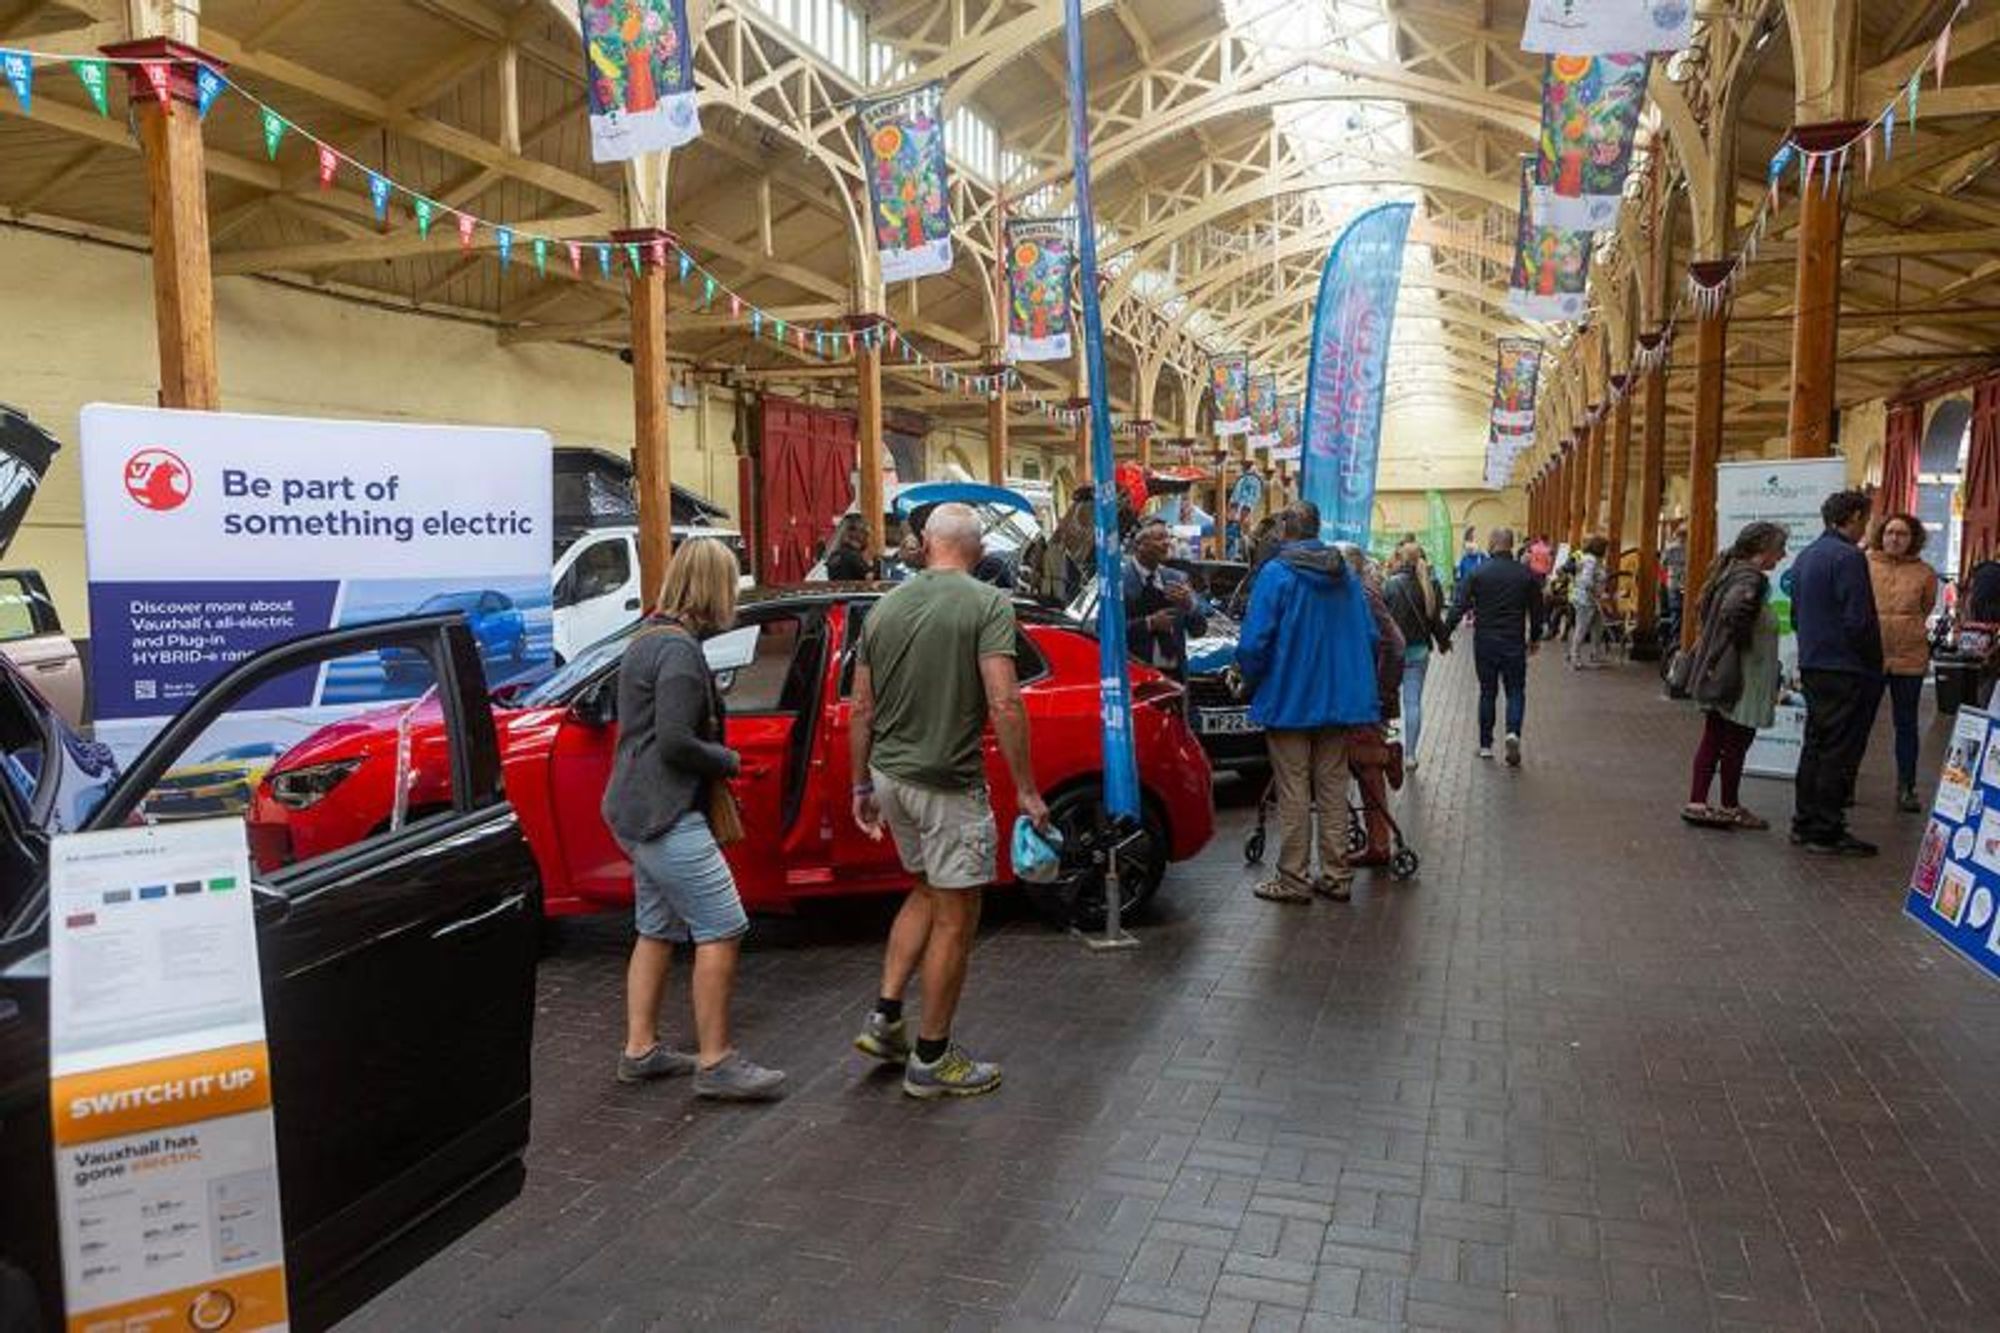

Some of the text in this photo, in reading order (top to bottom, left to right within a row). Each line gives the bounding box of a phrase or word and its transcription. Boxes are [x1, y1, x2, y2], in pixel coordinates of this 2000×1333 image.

[1314, 335, 1346, 457] FULLY
[1340, 309, 1383, 501] CHARGED
[222, 470, 399, 505] Be part of
[224, 510, 533, 543] something electric
[130, 600, 293, 614] Discover more about
[131, 615, 294, 631] Vauxhall's all-electric
[133, 634, 226, 648] and Plug-in
[132, 651, 218, 665] HYBRID-e
[70, 1068, 255, 1119] SWITCH IT UP
[75, 1134, 198, 1167] Vauxhall has
[75, 1165, 125, 1186] gone
